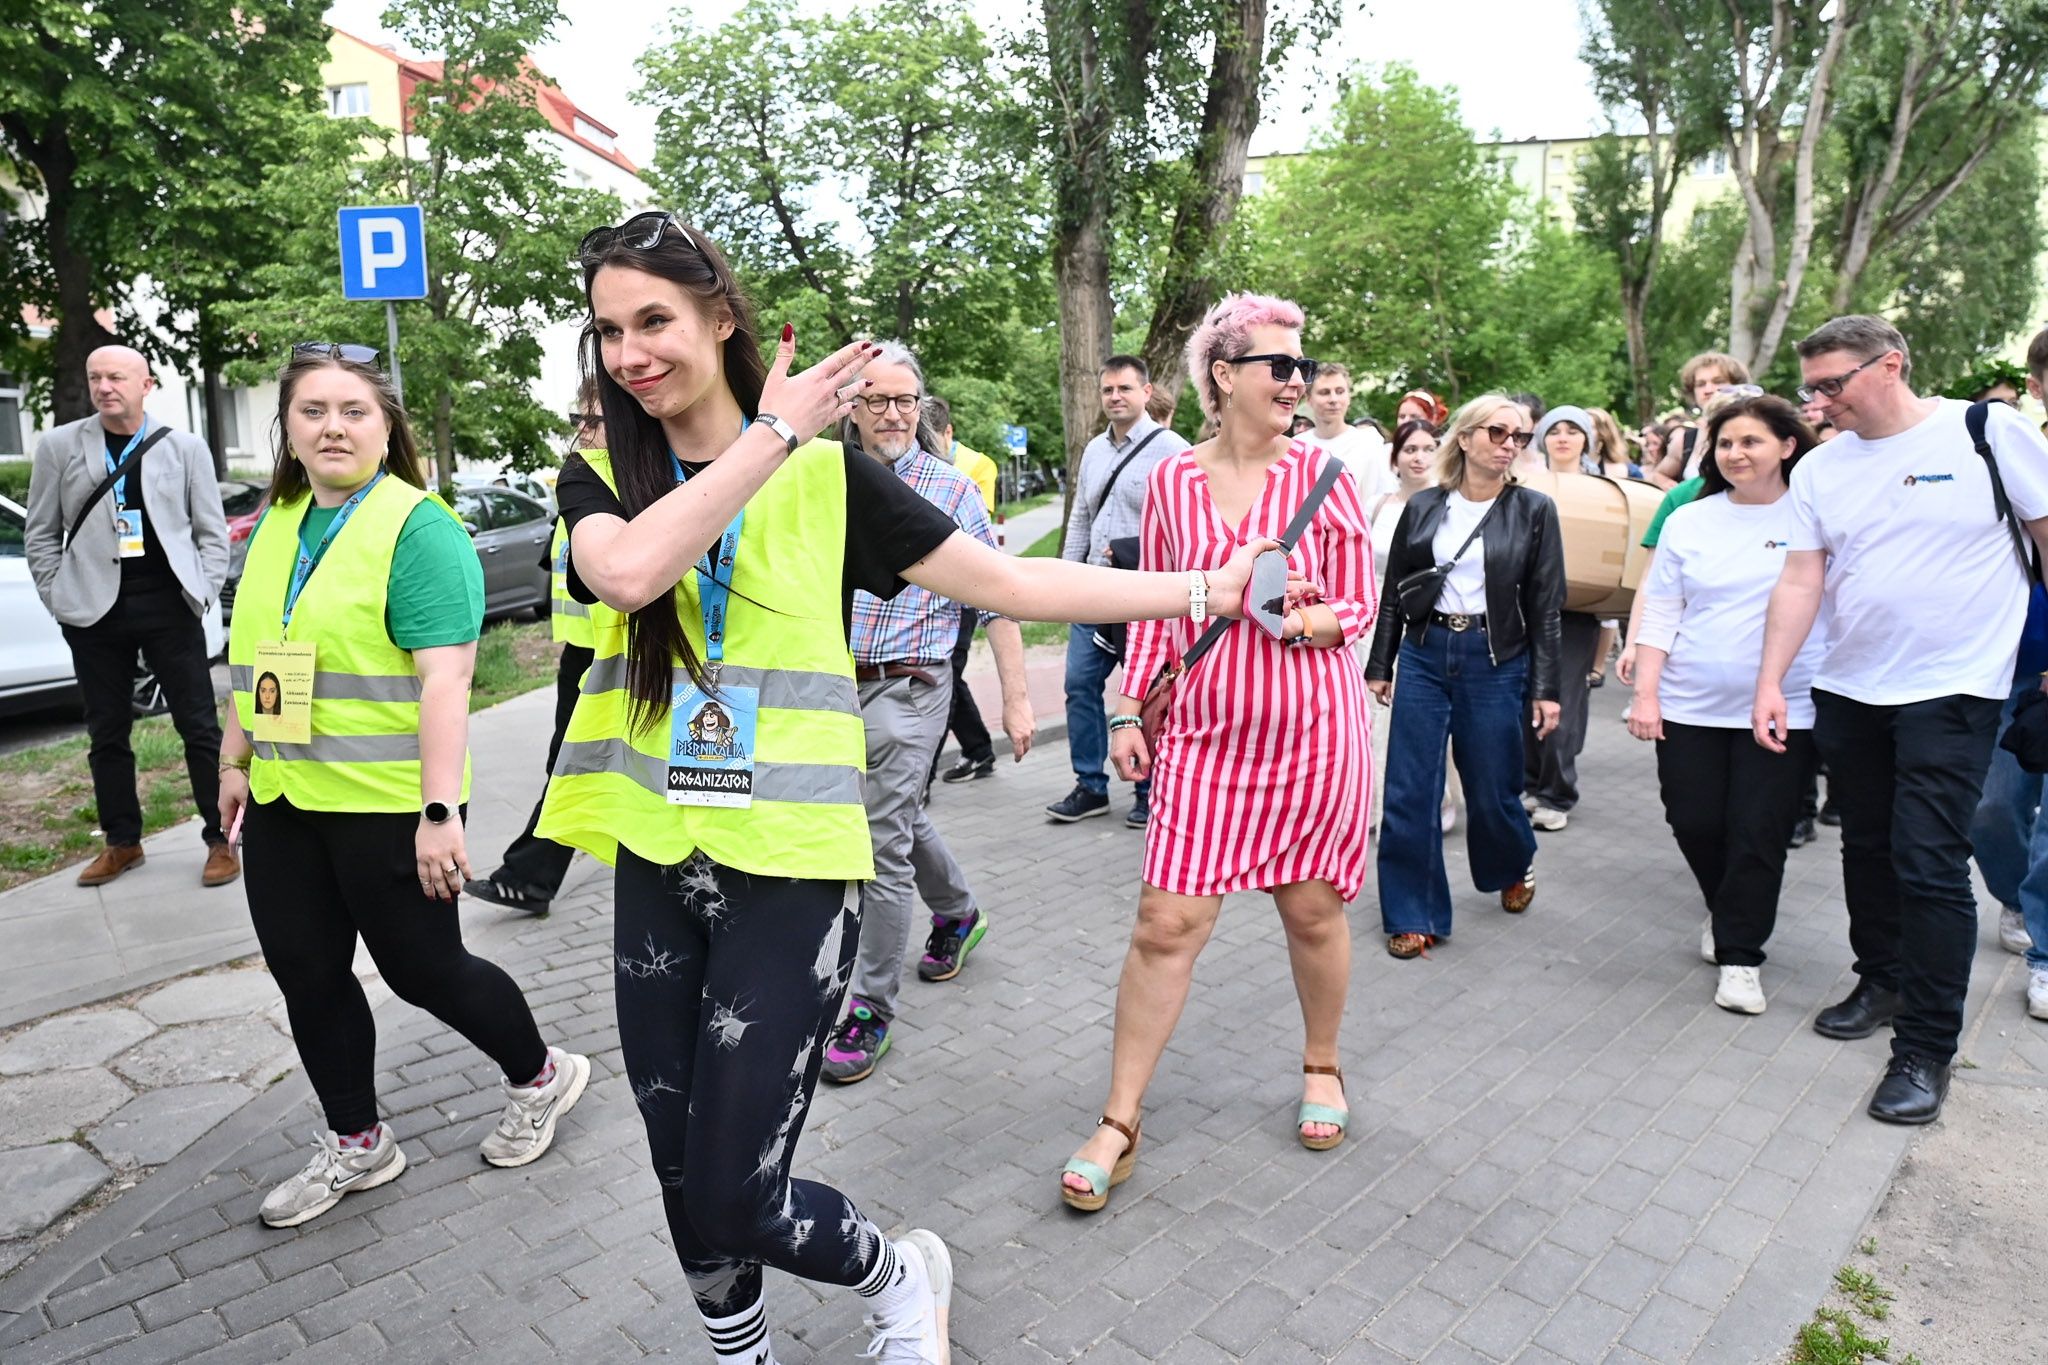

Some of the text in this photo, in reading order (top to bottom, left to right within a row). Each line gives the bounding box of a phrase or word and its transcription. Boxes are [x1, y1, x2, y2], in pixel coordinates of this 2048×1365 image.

[358, 217, 407, 289] P
[676, 740, 746, 759] PIERNIKALIA
[669, 771, 750, 789] ORGANIZATOR
